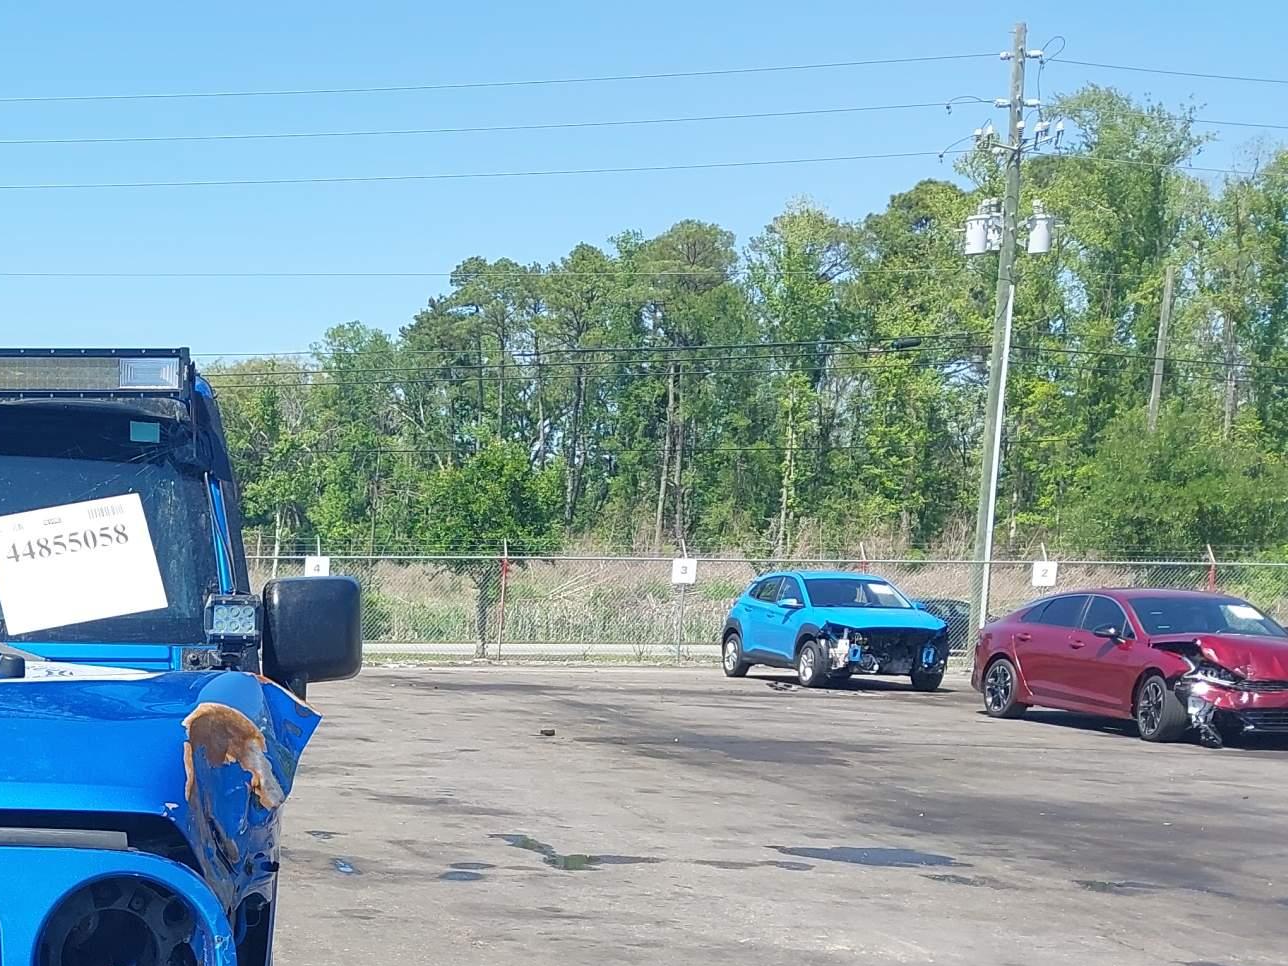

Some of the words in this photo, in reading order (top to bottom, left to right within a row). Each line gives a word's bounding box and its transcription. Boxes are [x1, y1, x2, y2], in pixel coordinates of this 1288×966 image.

[6, 523, 129, 562] 44855058
[680, 566, 688, 575] 3
[1041, 569, 1049, 578] 2
